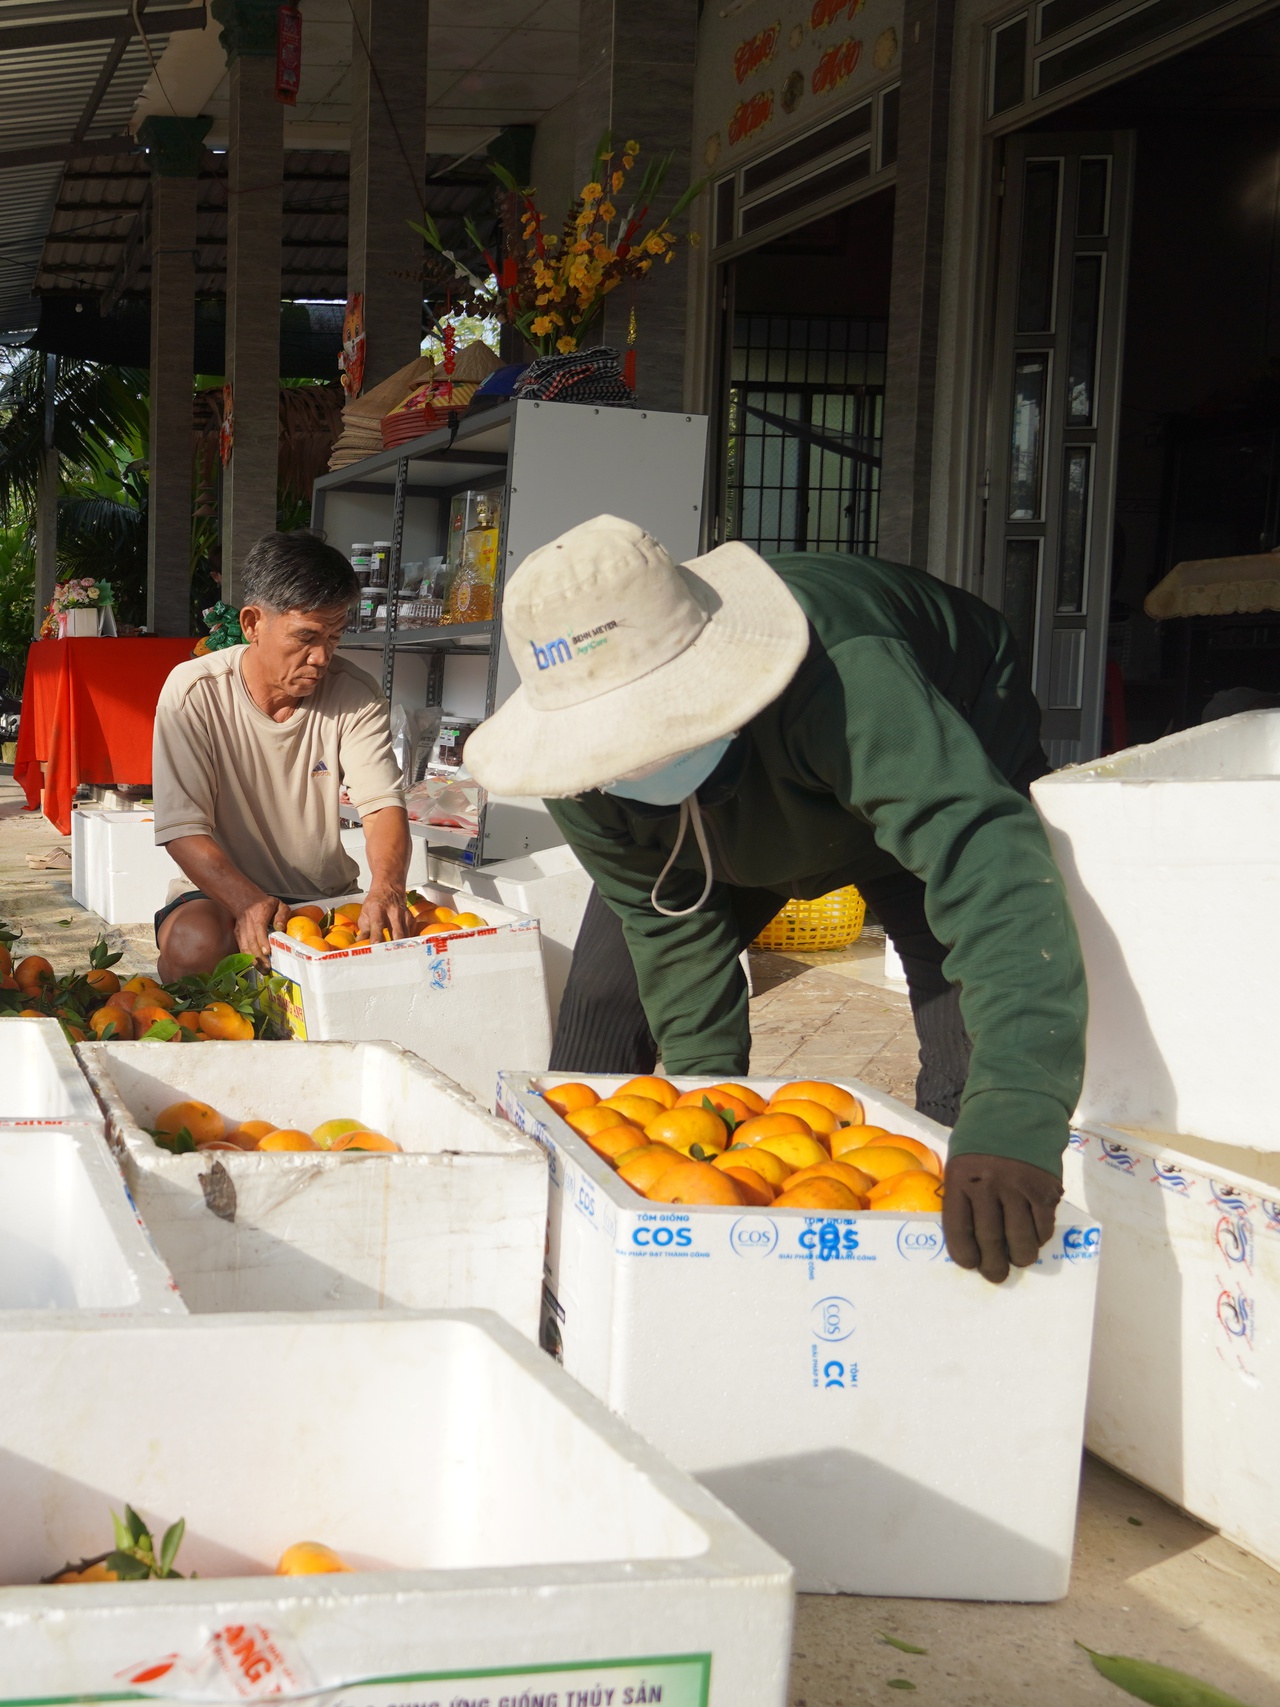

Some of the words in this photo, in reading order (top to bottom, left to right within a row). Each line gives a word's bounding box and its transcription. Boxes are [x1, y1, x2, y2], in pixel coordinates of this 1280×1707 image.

[572, 631, 592, 645] BEHN
[591, 620, 618, 636] MEYER
[529, 637, 573, 671] bm
[637, 1212, 657, 1222] TÔM
[659, 1212, 690, 1222] GIỐNG
[632, 1226, 693, 1247] COS
[738, 1230, 770, 1244] COS
[905, 1233, 937, 1247] COS
[826, 1303, 841, 1335] COS
[565, 1682, 616, 1707] THỦY
[622, 1679, 663, 1706] SẢN
